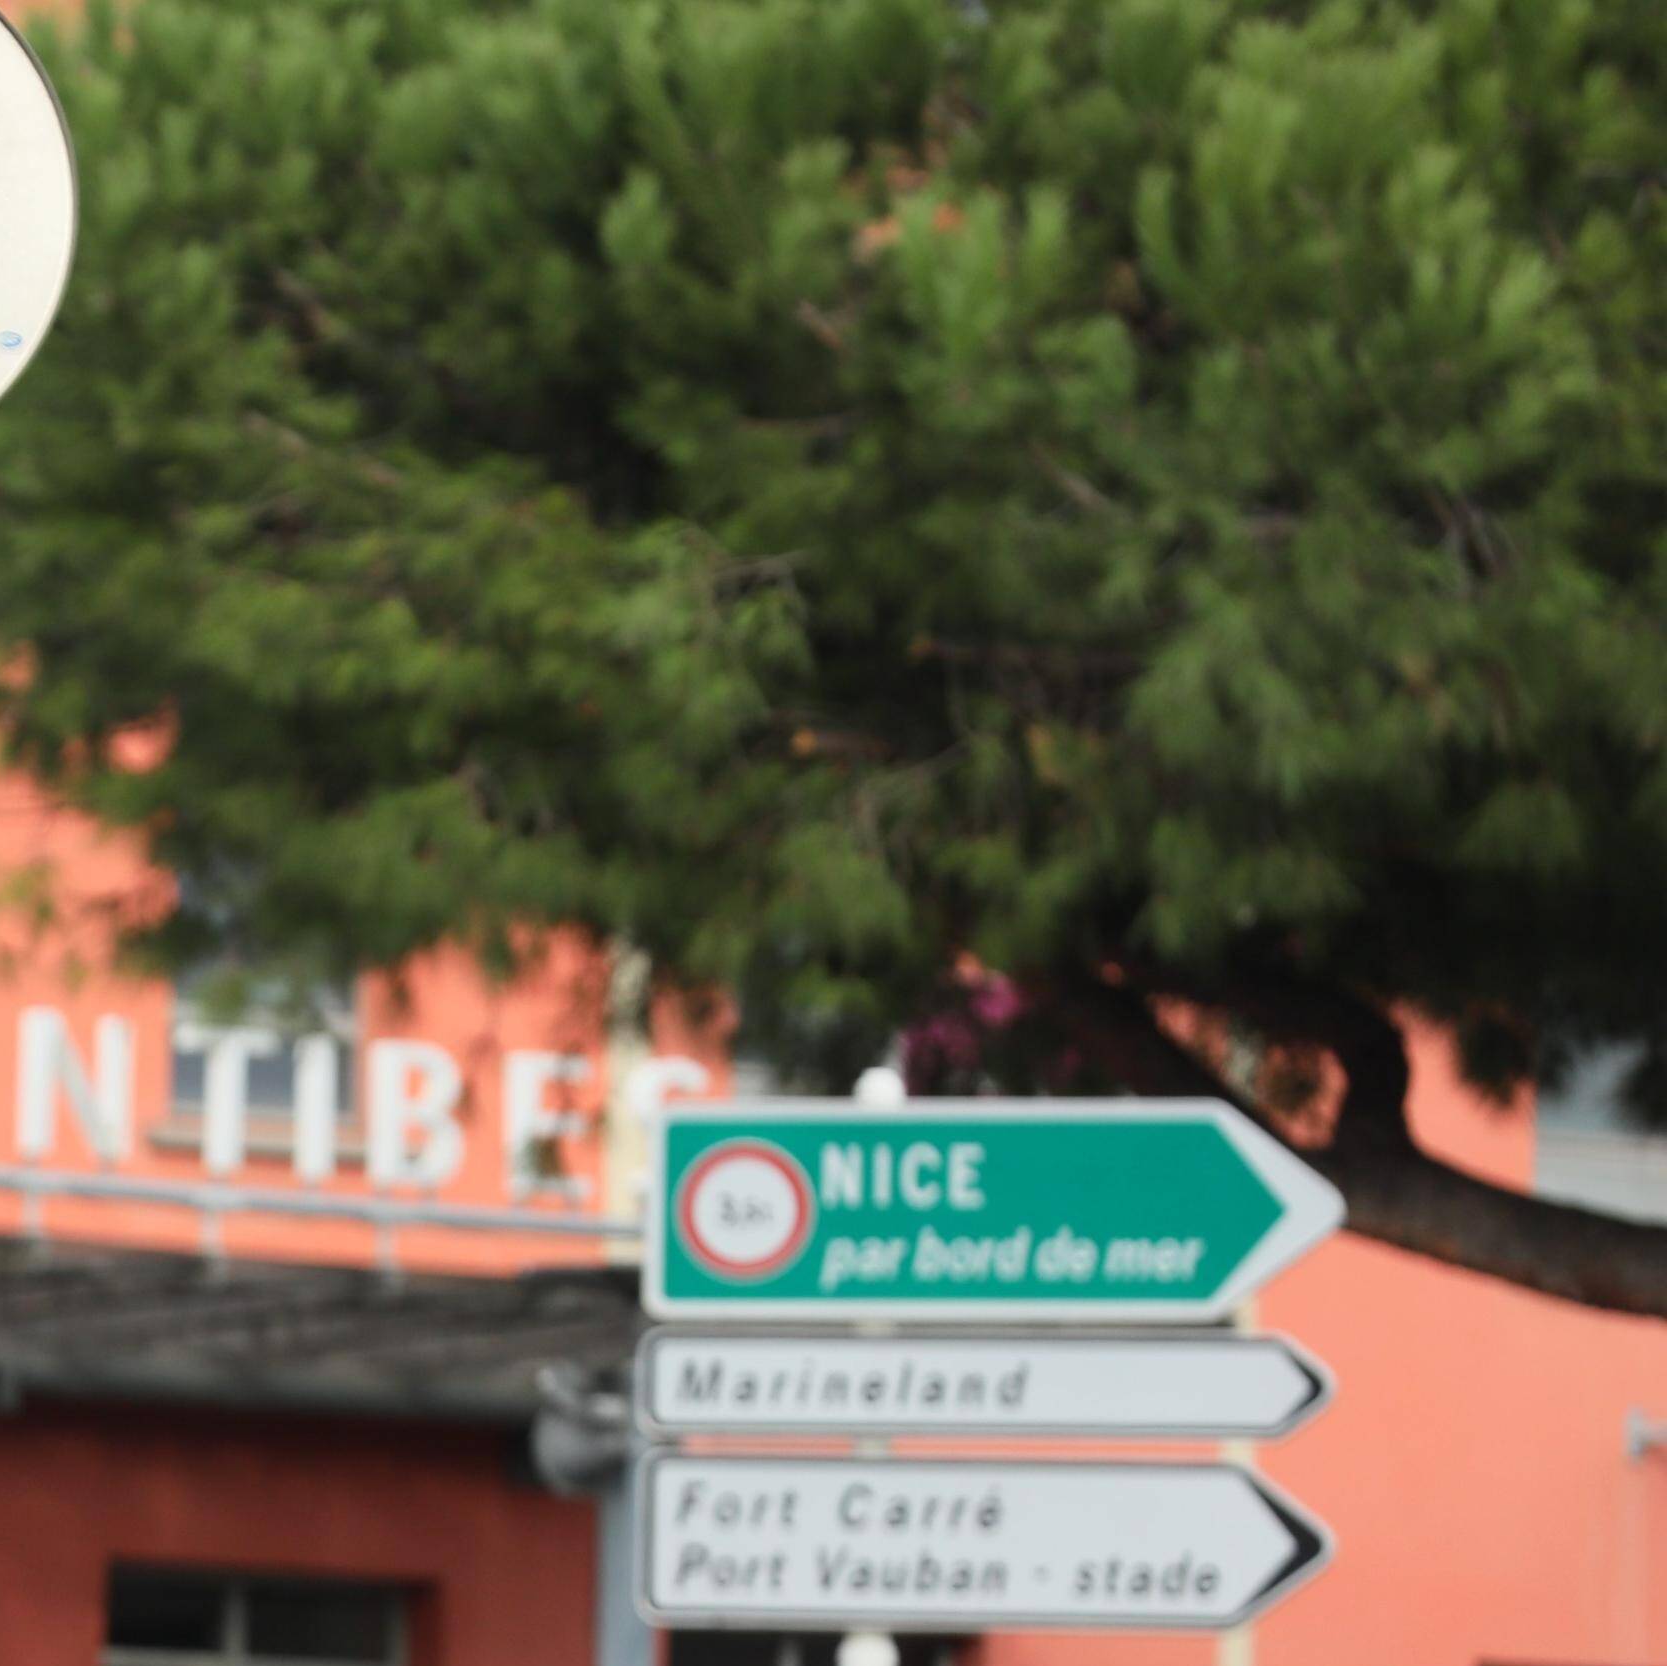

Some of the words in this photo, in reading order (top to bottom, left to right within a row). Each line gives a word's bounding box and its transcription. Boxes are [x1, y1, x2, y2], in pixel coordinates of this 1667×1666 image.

[820, 1143, 986, 1210] NICE
[819, 1233, 905, 1292] par
[913, 1225, 1033, 1283] bord
[1039, 1226, 1099, 1283] de
[1103, 1235, 1206, 1283] mer
[676, 1360, 1031, 1407] Marineland
[675, 1481, 799, 1527] Fort
[837, 1482, 1006, 1531] Carré
[674, 1541, 788, 1591] Port
[815, 1546, 1009, 1595] Vauban
[1075, 1550, 1223, 1599] stade
